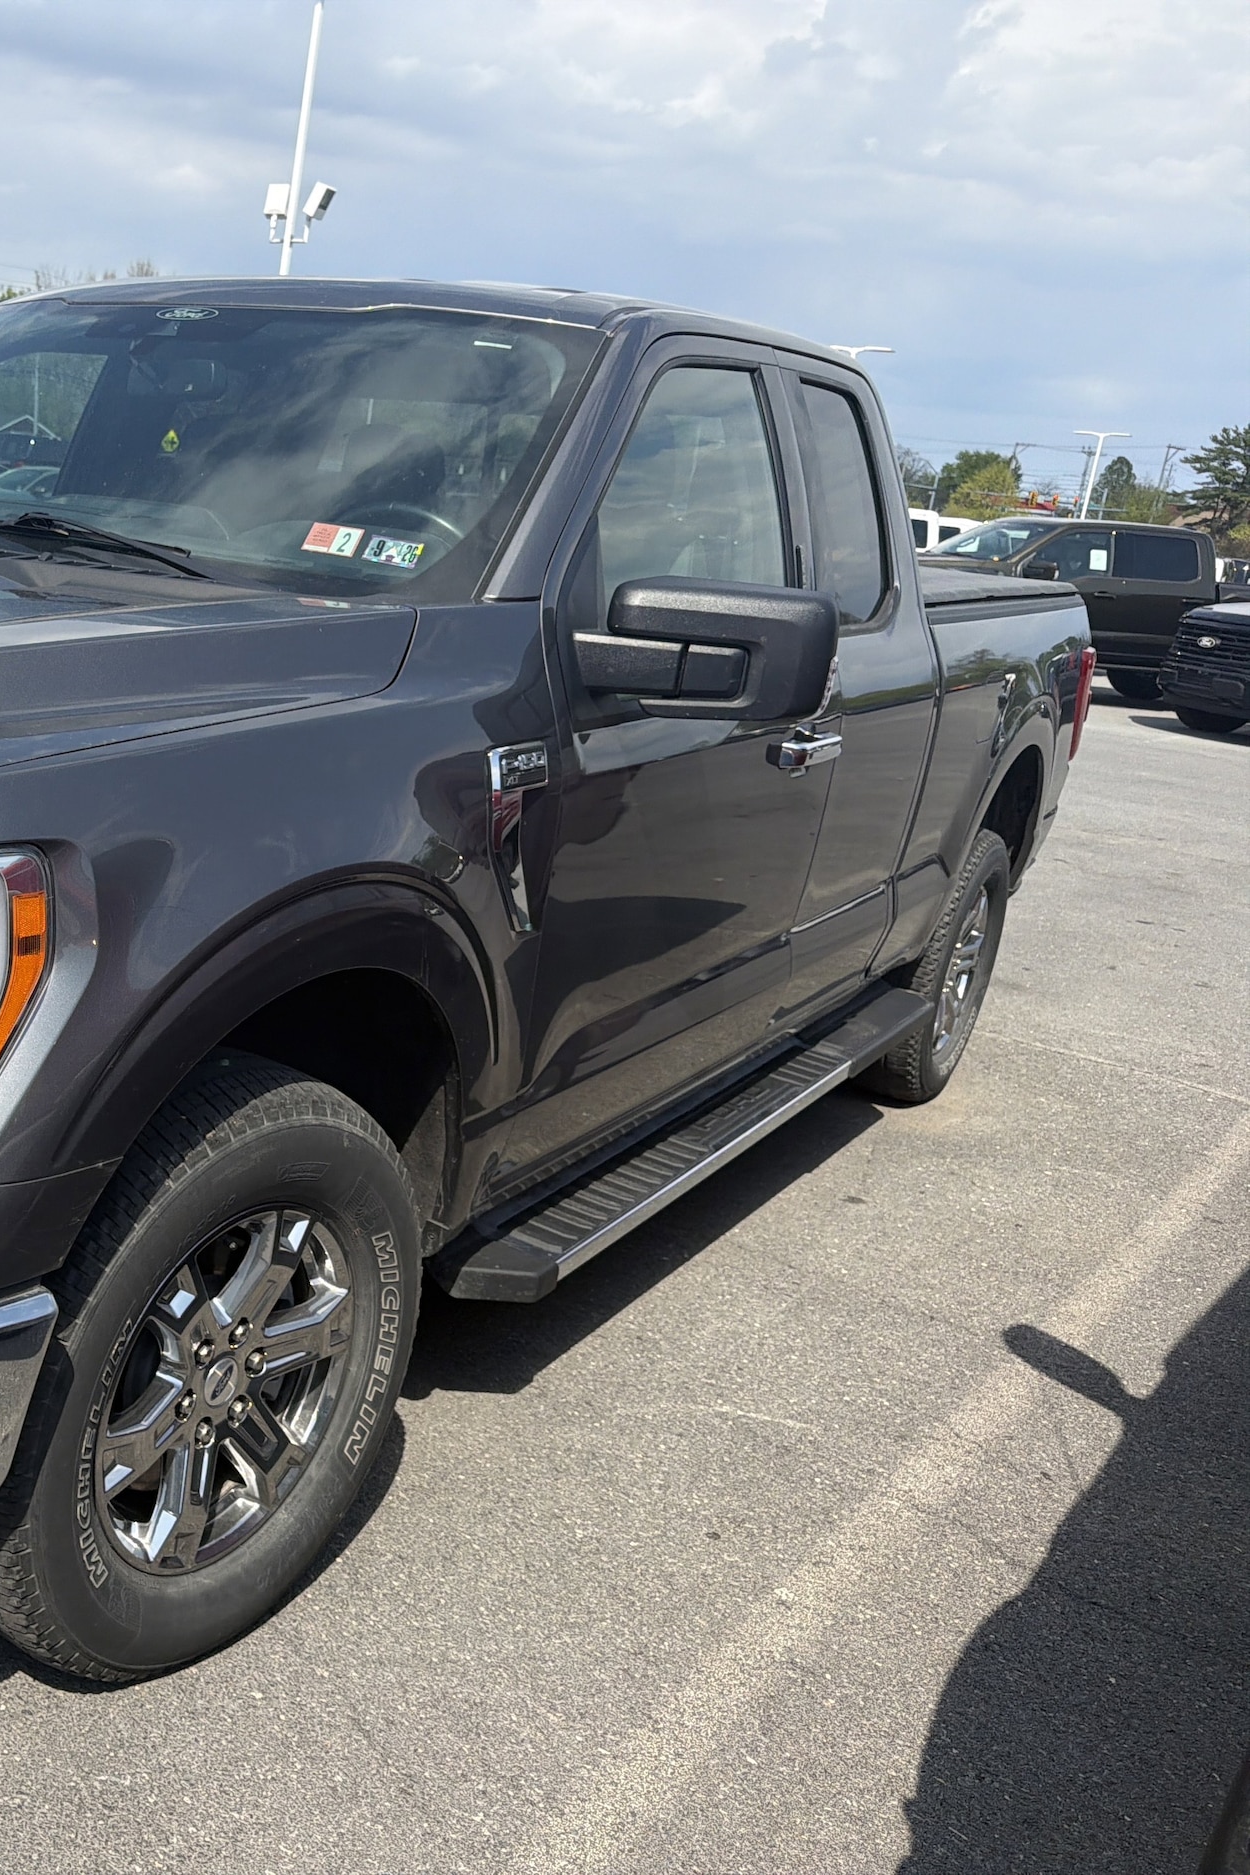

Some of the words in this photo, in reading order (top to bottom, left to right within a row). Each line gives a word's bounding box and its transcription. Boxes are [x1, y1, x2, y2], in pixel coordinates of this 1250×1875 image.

[336, 532, 352, 553] 2
[373, 539, 386, 557] 9
[342, 1231, 401, 1466] MICHELIN
[76, 1318, 134, 1589] MICHELIN
